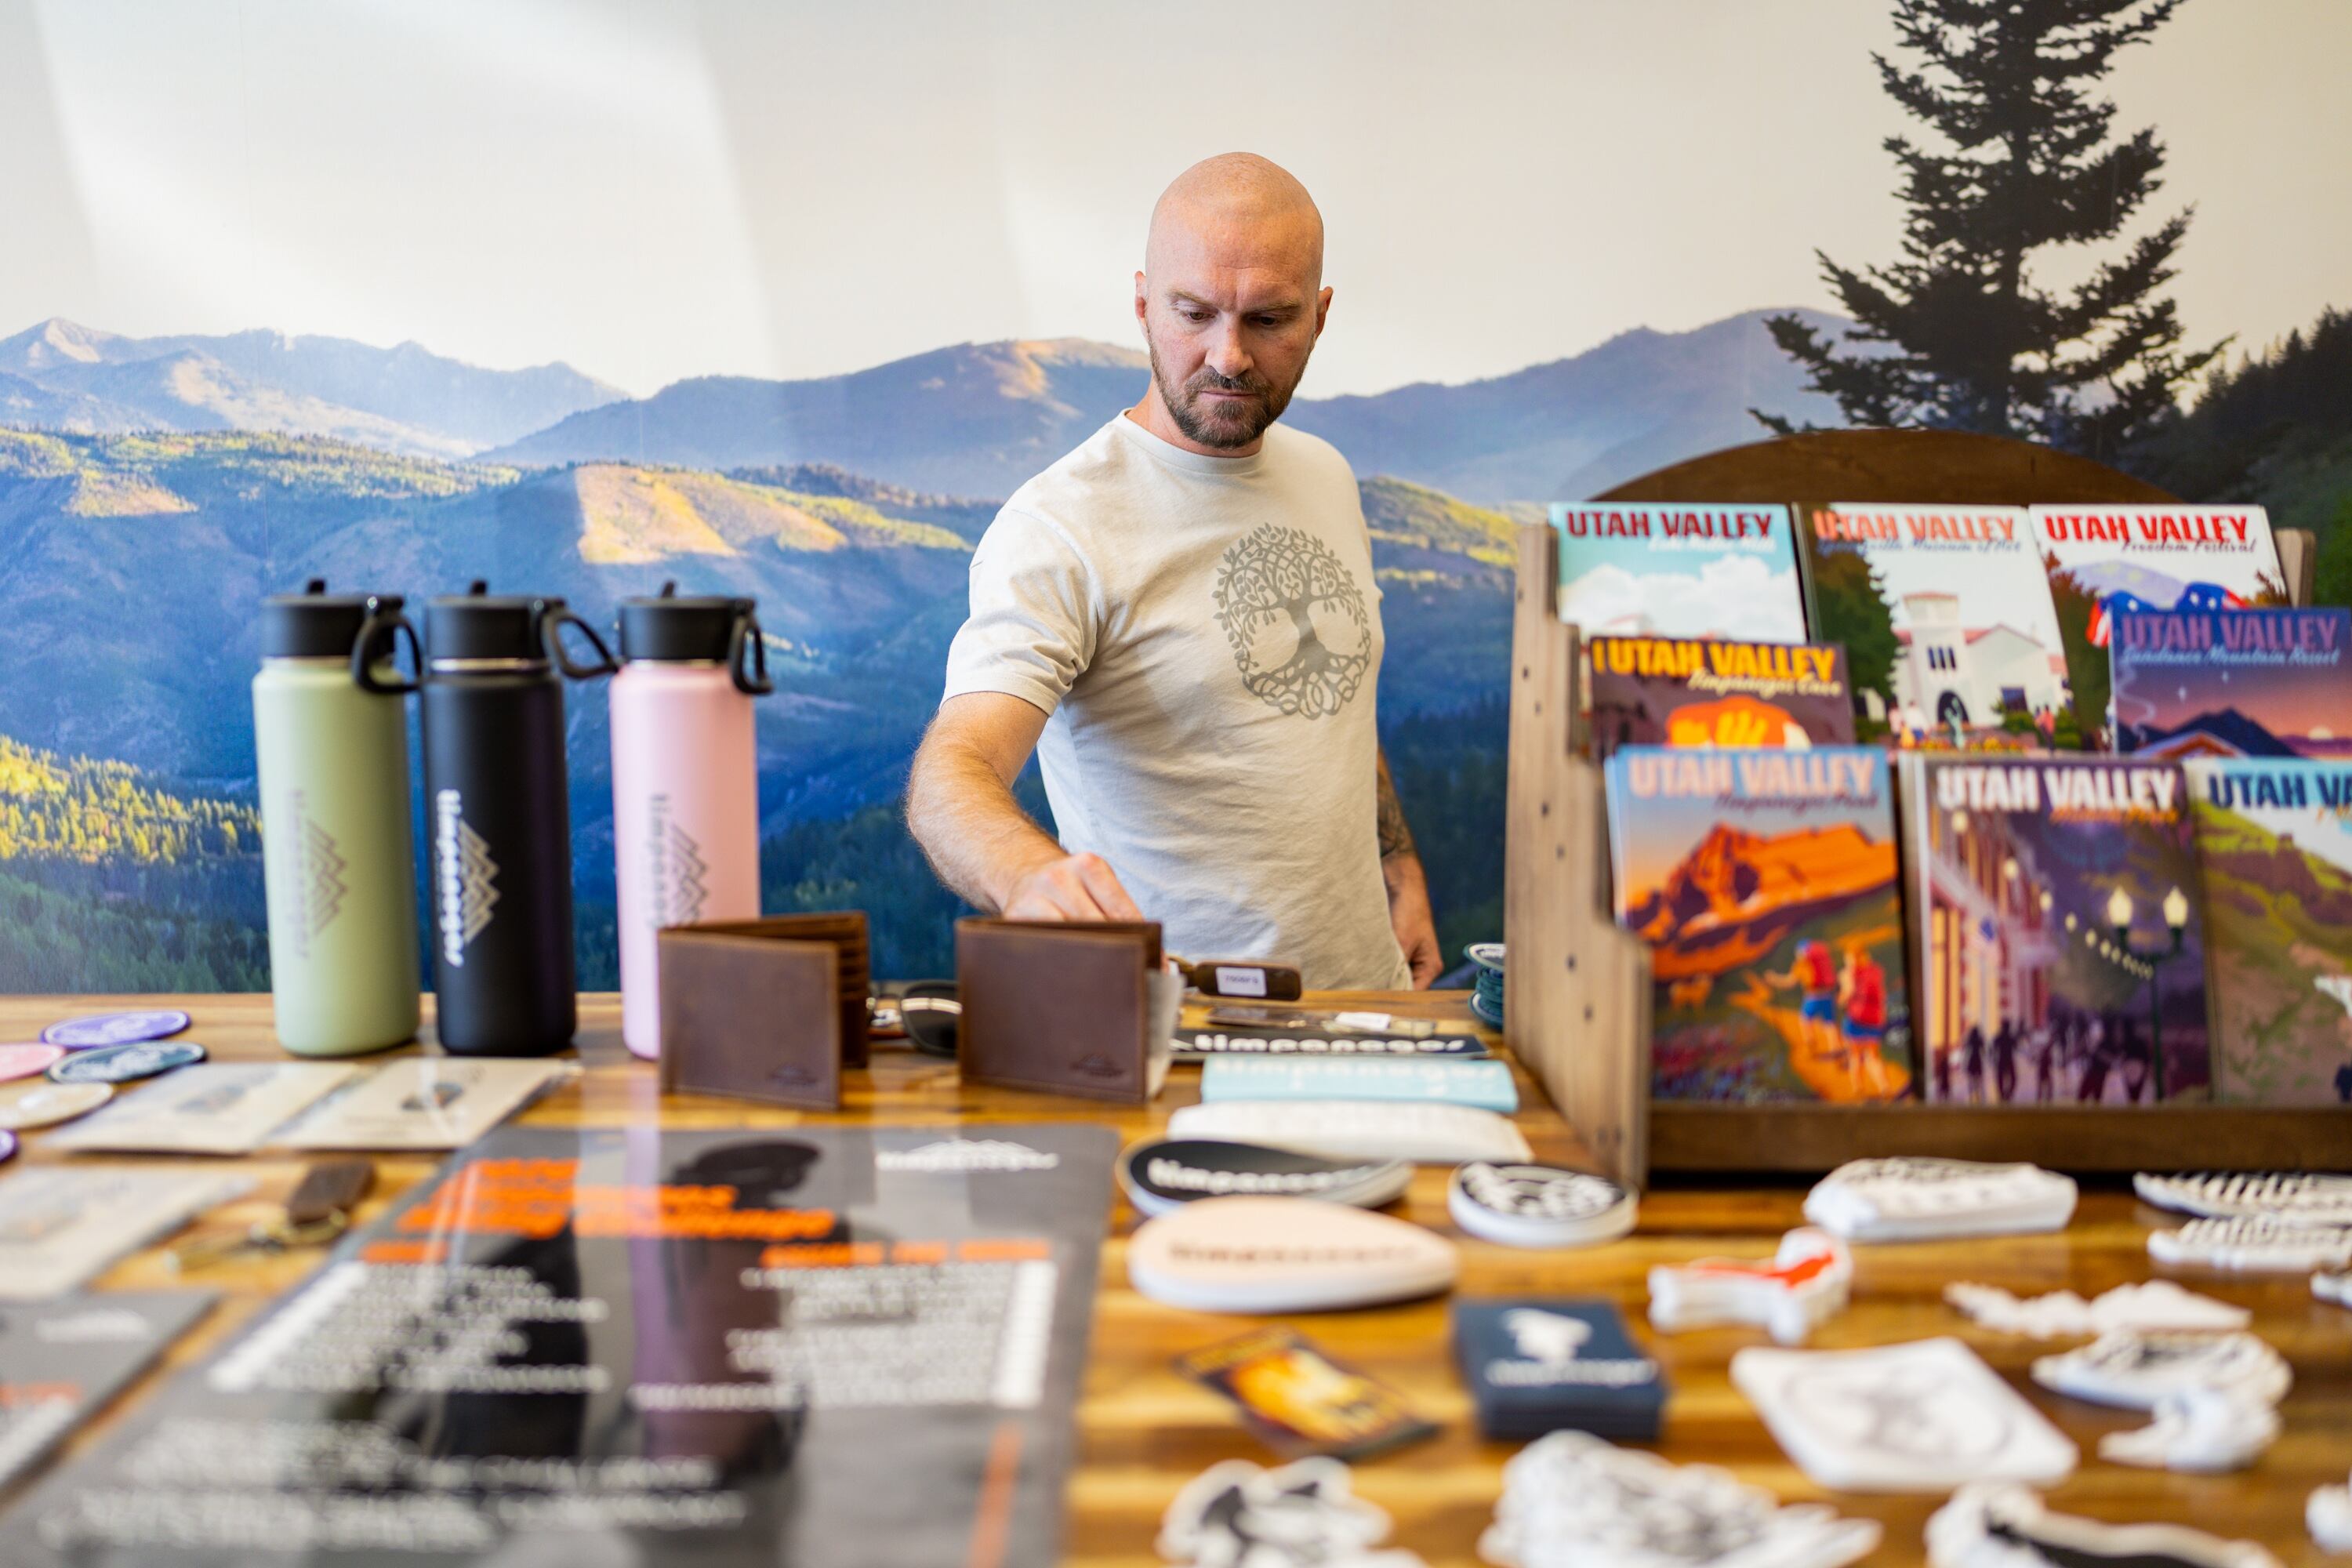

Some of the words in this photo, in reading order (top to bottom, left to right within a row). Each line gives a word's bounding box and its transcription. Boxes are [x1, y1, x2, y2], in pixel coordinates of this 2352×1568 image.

[1566, 511, 1650, 538] UTAH
[1660, 512, 1772, 539] VALLEY
[1813, 510, 1898, 541] UTAH
[1905, 514, 2013, 542] VALLEY
[2044, 514, 2129, 542] UTAH
[2136, 515, 2248, 543] VALLEY
[2122, 537, 2189, 554] Freedom
[2193, 537, 2257, 554] Festival
[2122, 614, 2212, 651] UTAH
[2219, 615, 2337, 652] VALLEY
[1607, 637, 1704, 677] UTAH
[1708, 642, 1835, 683] VALLEY
[1628, 753, 1733, 799] UTAH
[1738, 753, 1875, 797] VALLEY
[1936, 766, 2038, 811] UTAH
[2042, 767, 2176, 811] VALLEY
[2208, 773, 2307, 809] UTAH
